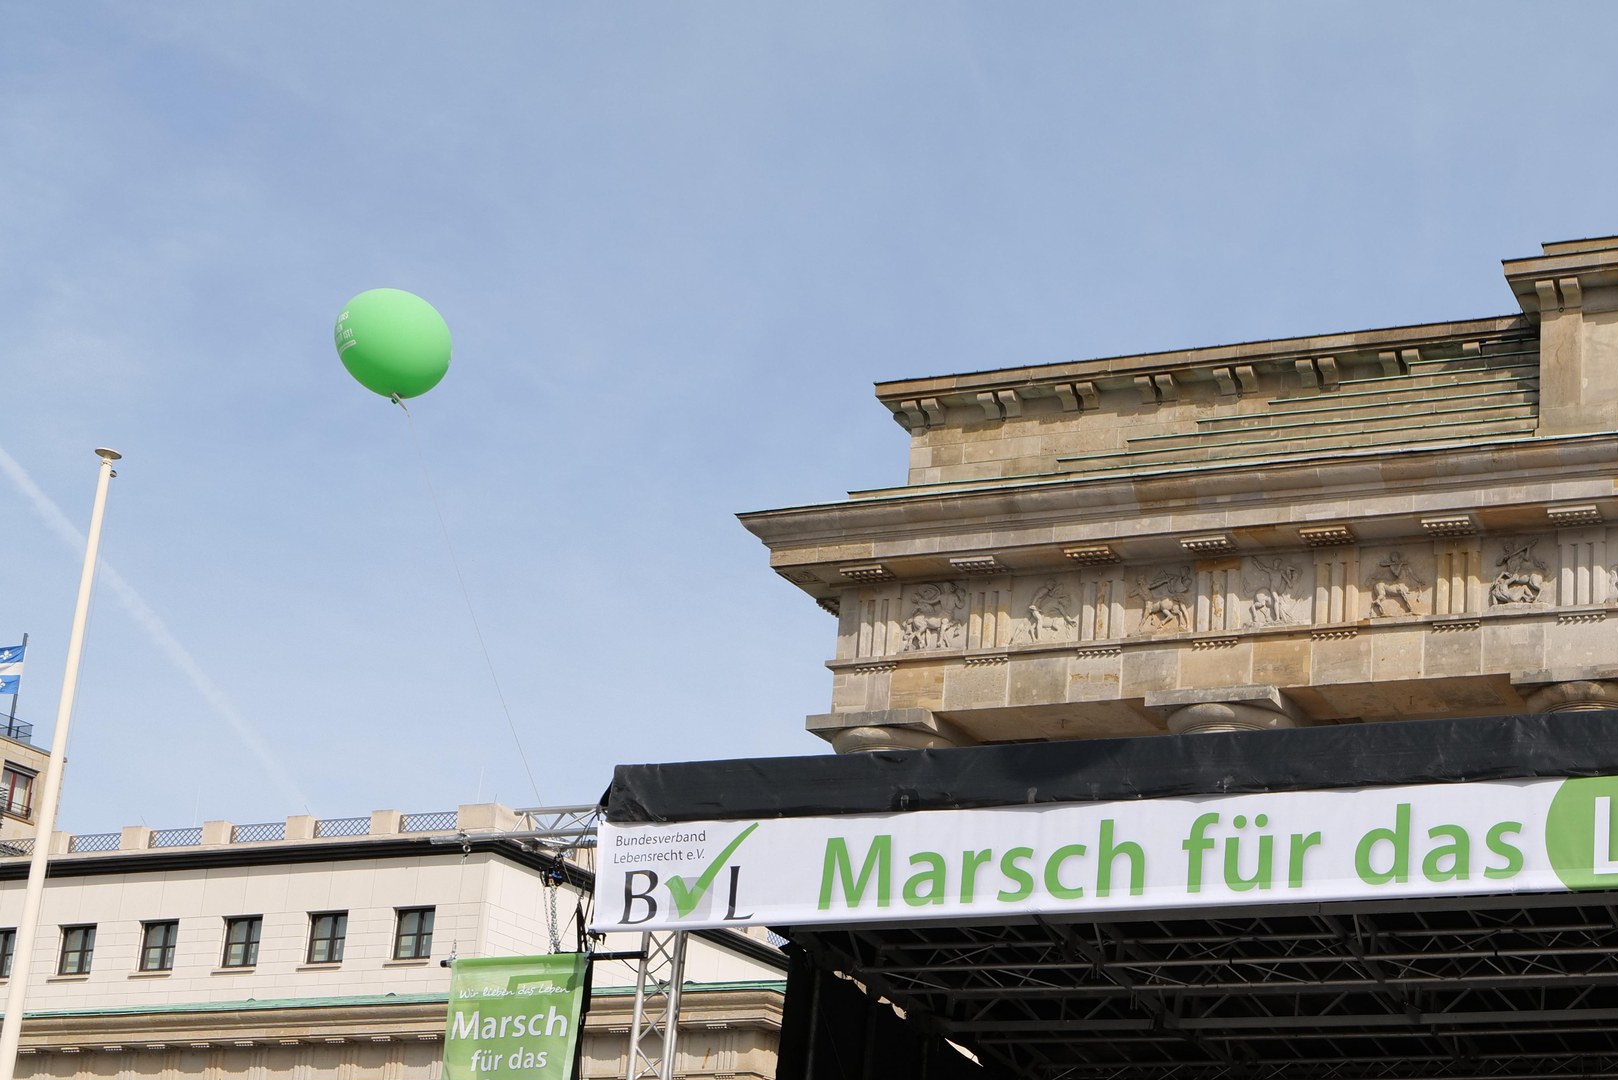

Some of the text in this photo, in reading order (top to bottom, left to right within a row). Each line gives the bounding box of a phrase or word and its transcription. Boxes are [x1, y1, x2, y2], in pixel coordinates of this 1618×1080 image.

[616, 830, 706, 846] Bundesverband
[614, 849, 705, 864] Lebensrecht e.V.
[818, 820, 1145, 911] Marsch
[1181, 812, 1321, 894] für
[1354, 803, 1524, 885] das
[483, 986, 515, 997] lieben
[518, 985, 536, 995] das
[538, 983, 570, 994] Leben
[451, 1006, 568, 1040] Marsch
[470, 1047, 548, 1072] für das
